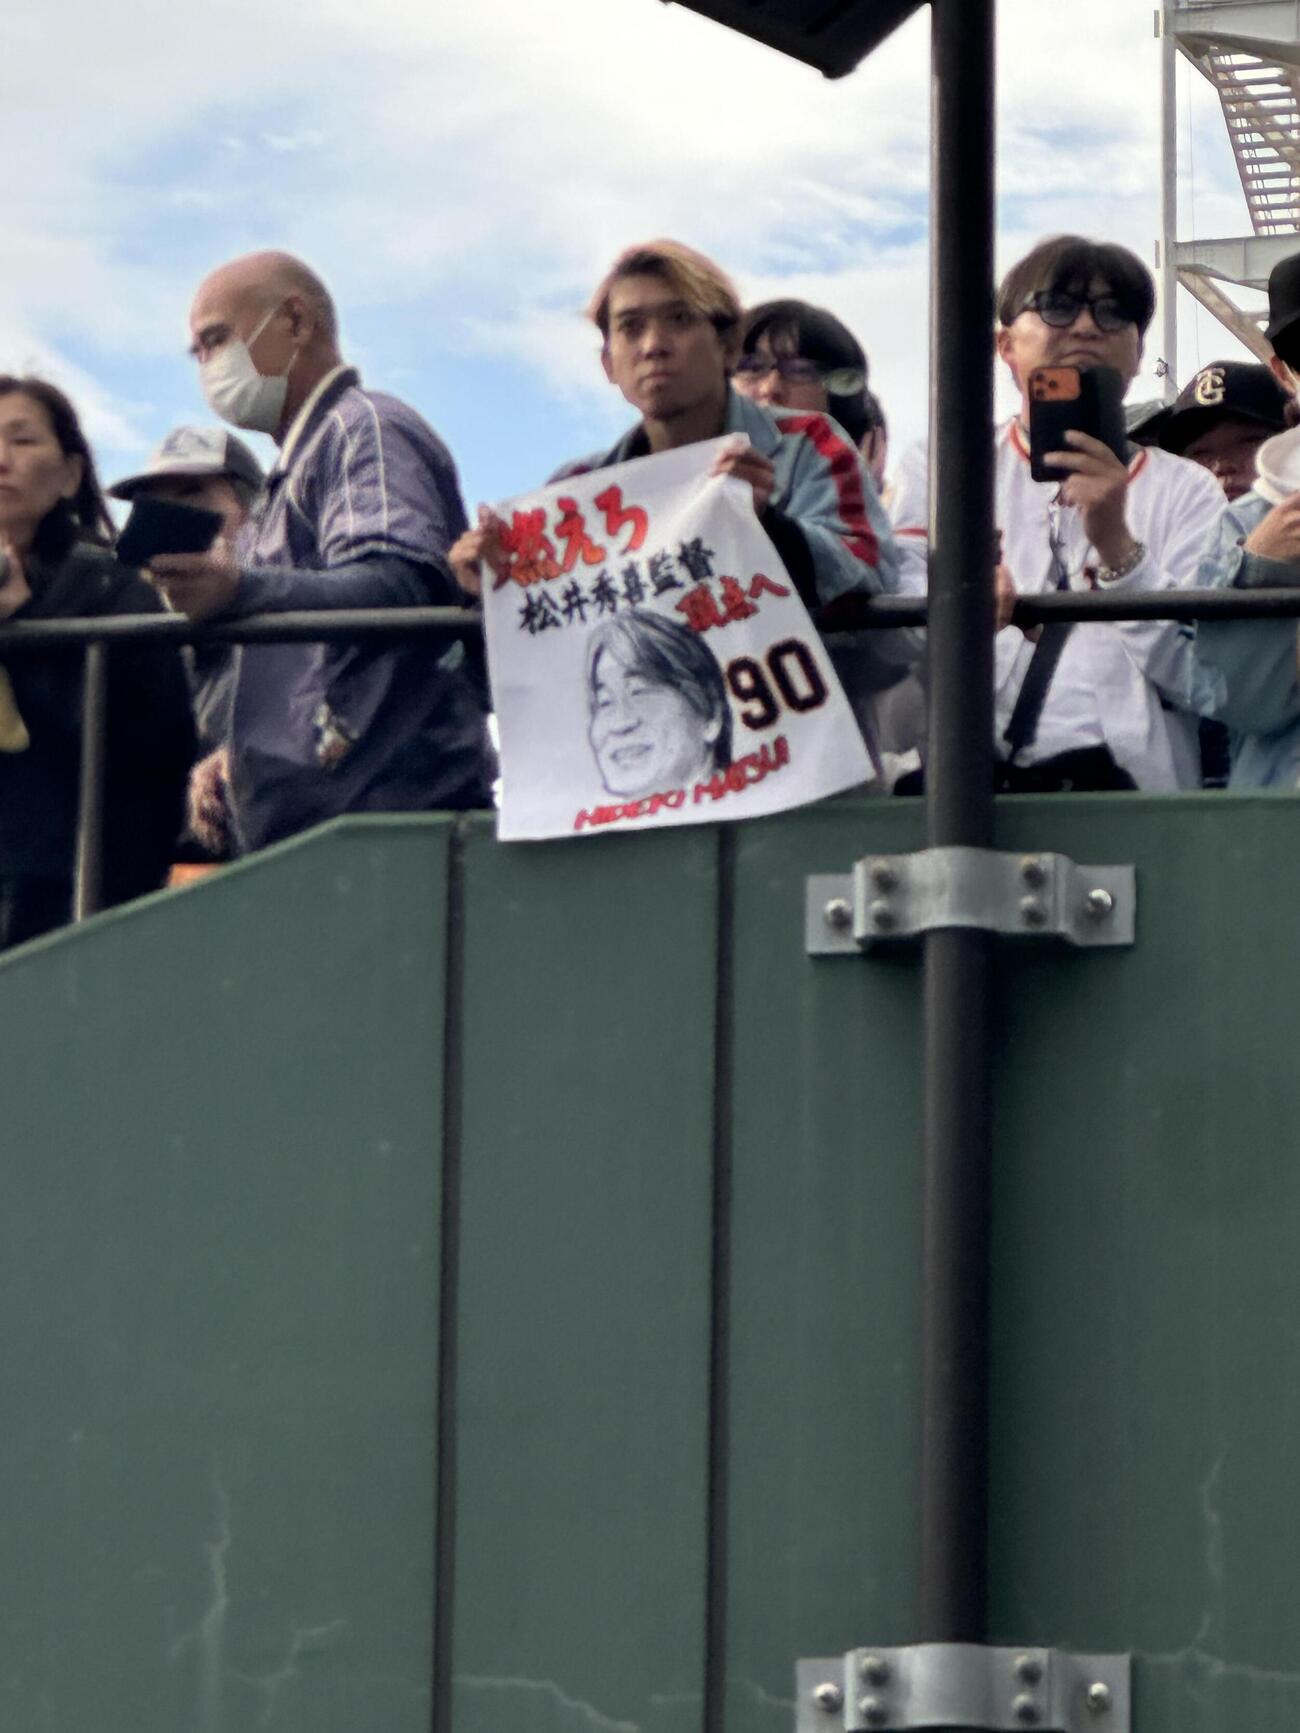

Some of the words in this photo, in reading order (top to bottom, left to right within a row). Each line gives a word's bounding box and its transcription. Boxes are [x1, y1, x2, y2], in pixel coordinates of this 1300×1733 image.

[519, 537, 714, 634] 松井秀喜監督
[726, 638, 828, 730] 90
